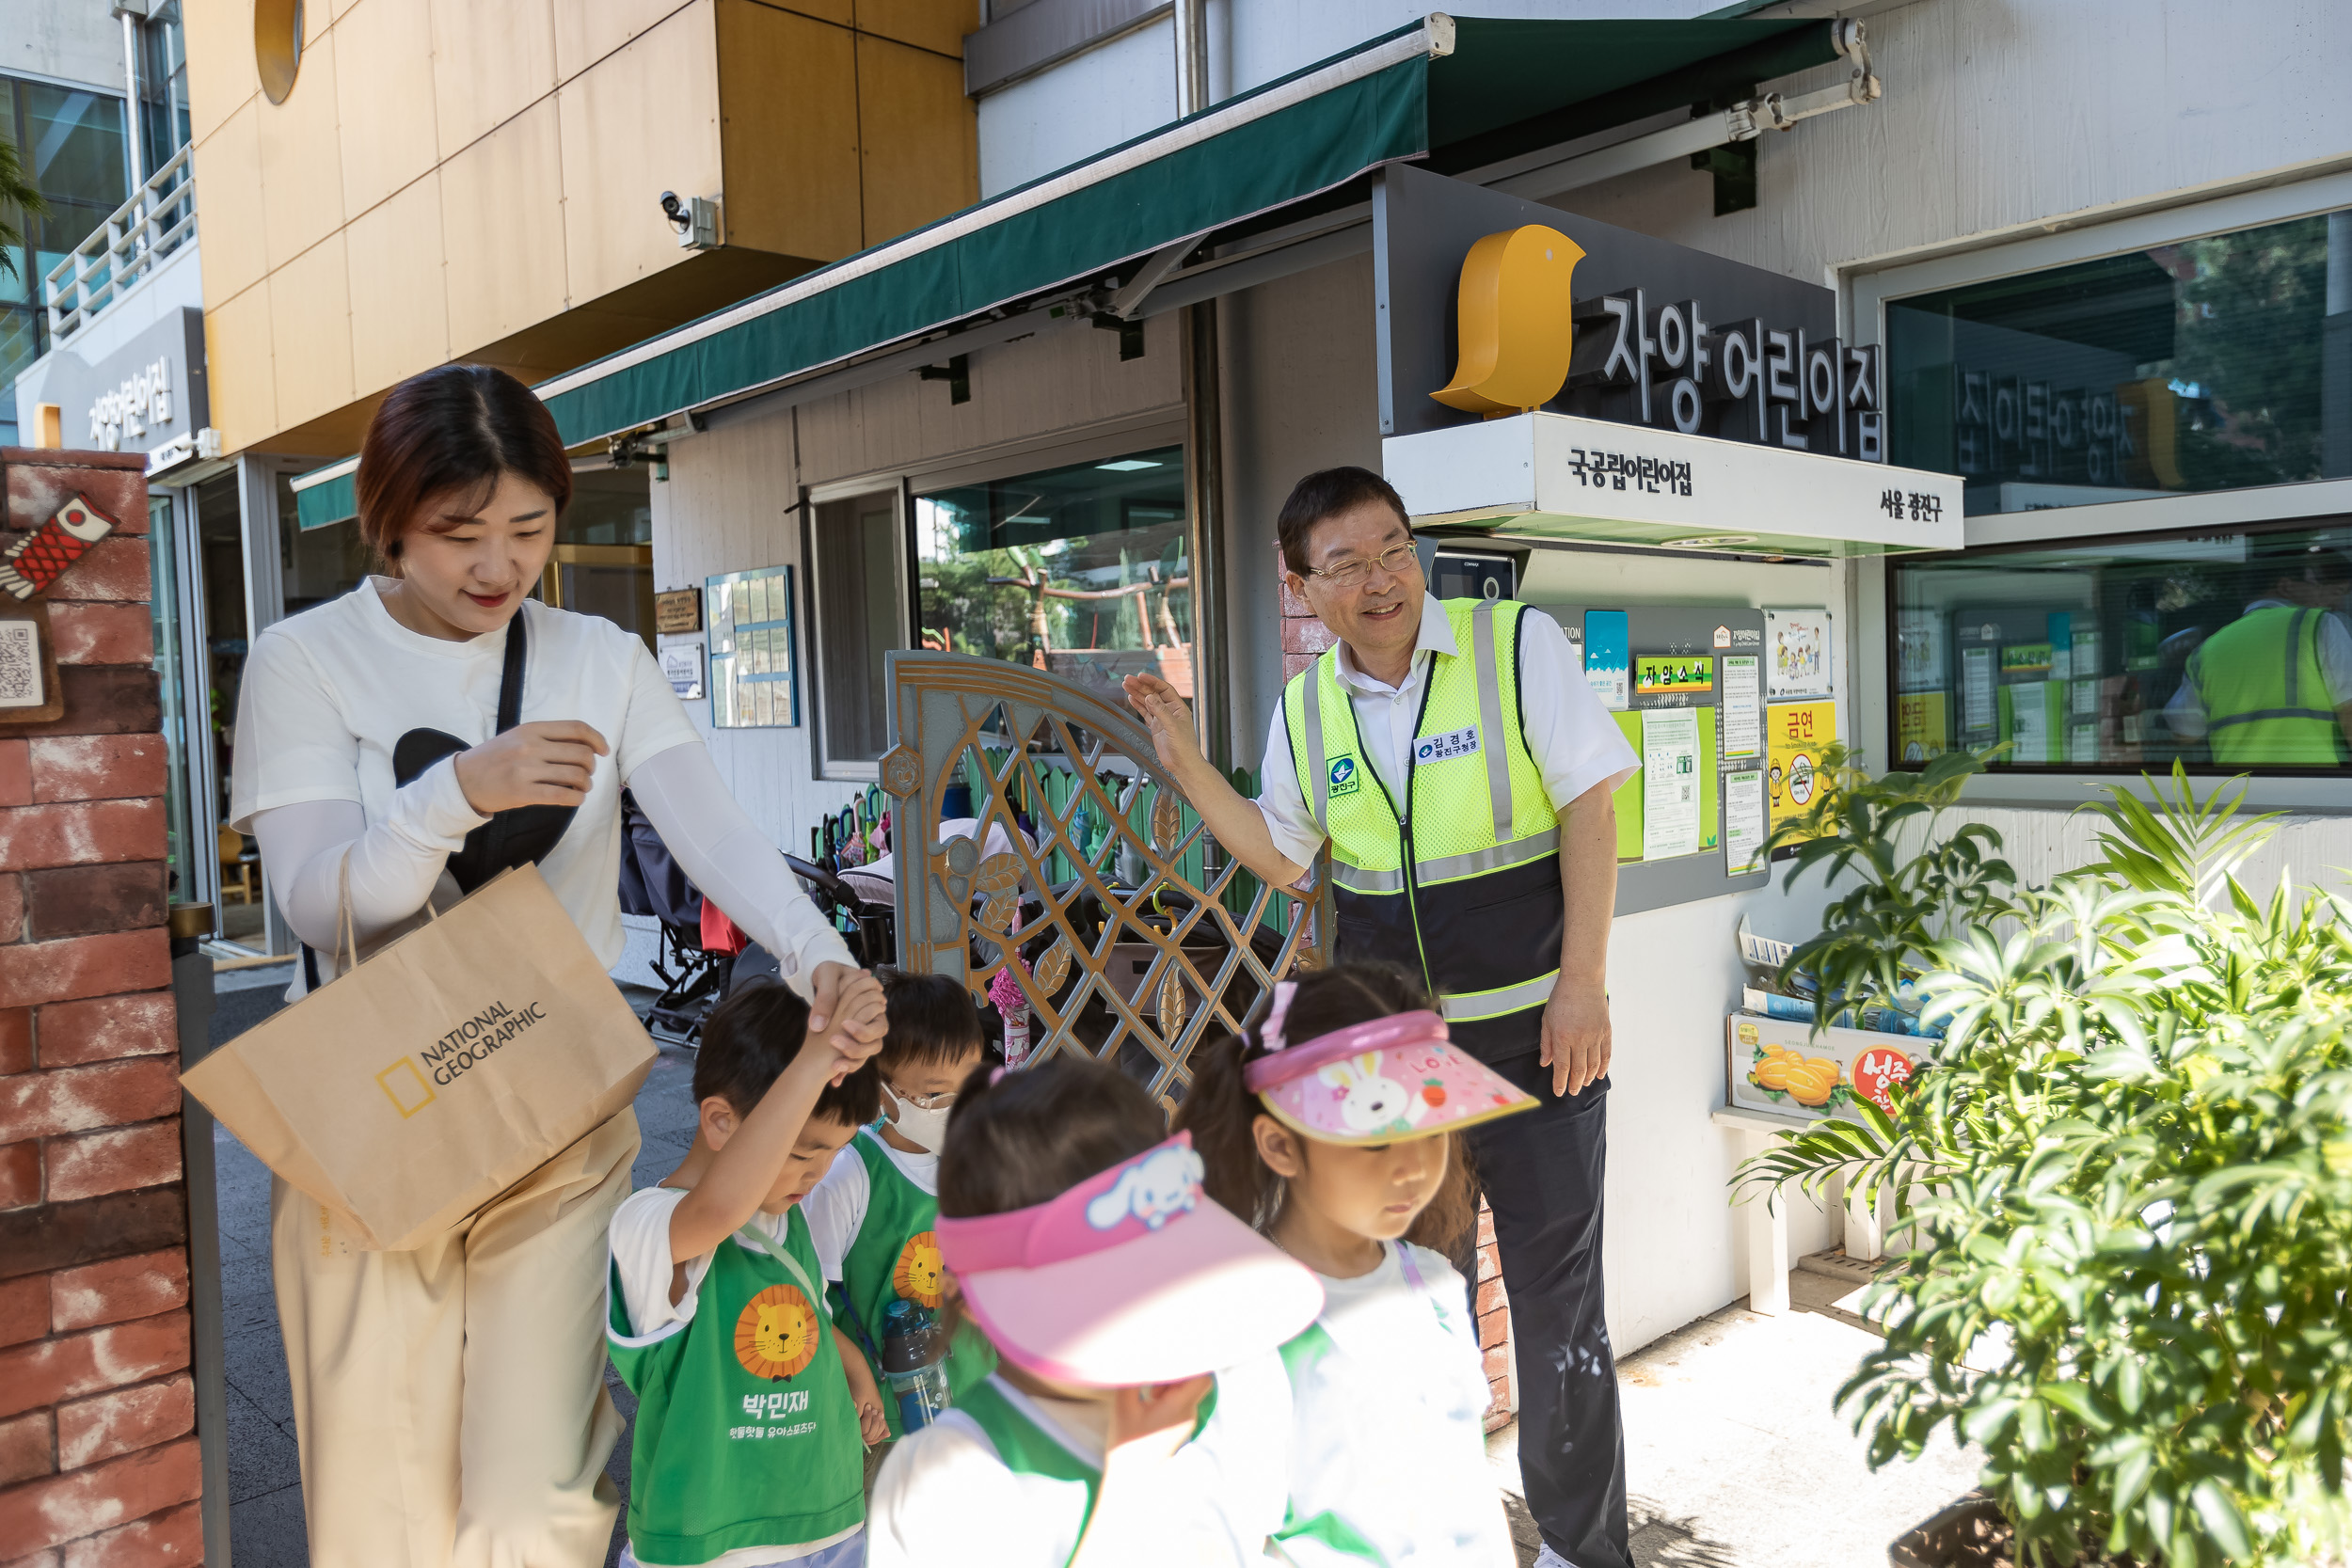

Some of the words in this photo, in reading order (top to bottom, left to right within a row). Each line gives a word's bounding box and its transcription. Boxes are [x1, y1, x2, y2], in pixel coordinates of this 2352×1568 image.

[1603, 286, 1711, 435] 자양
[1723, 315, 1883, 463] 어린이집
[1568, 449, 1692, 497] 국공립어린이집
[1880, 489, 1905, 519] 서울
[1907, 492, 1944, 524] 광진구
[1787, 710, 1814, 740] 금연
[1435, 741, 1477, 758] 광진구청장
[1331, 781, 1356, 794] 광진구
[421, 1000, 514, 1068] NATIONAL
[434, 1001, 547, 1086] GEOGRAPHIC
[742, 1389, 809, 1420] 박민재
